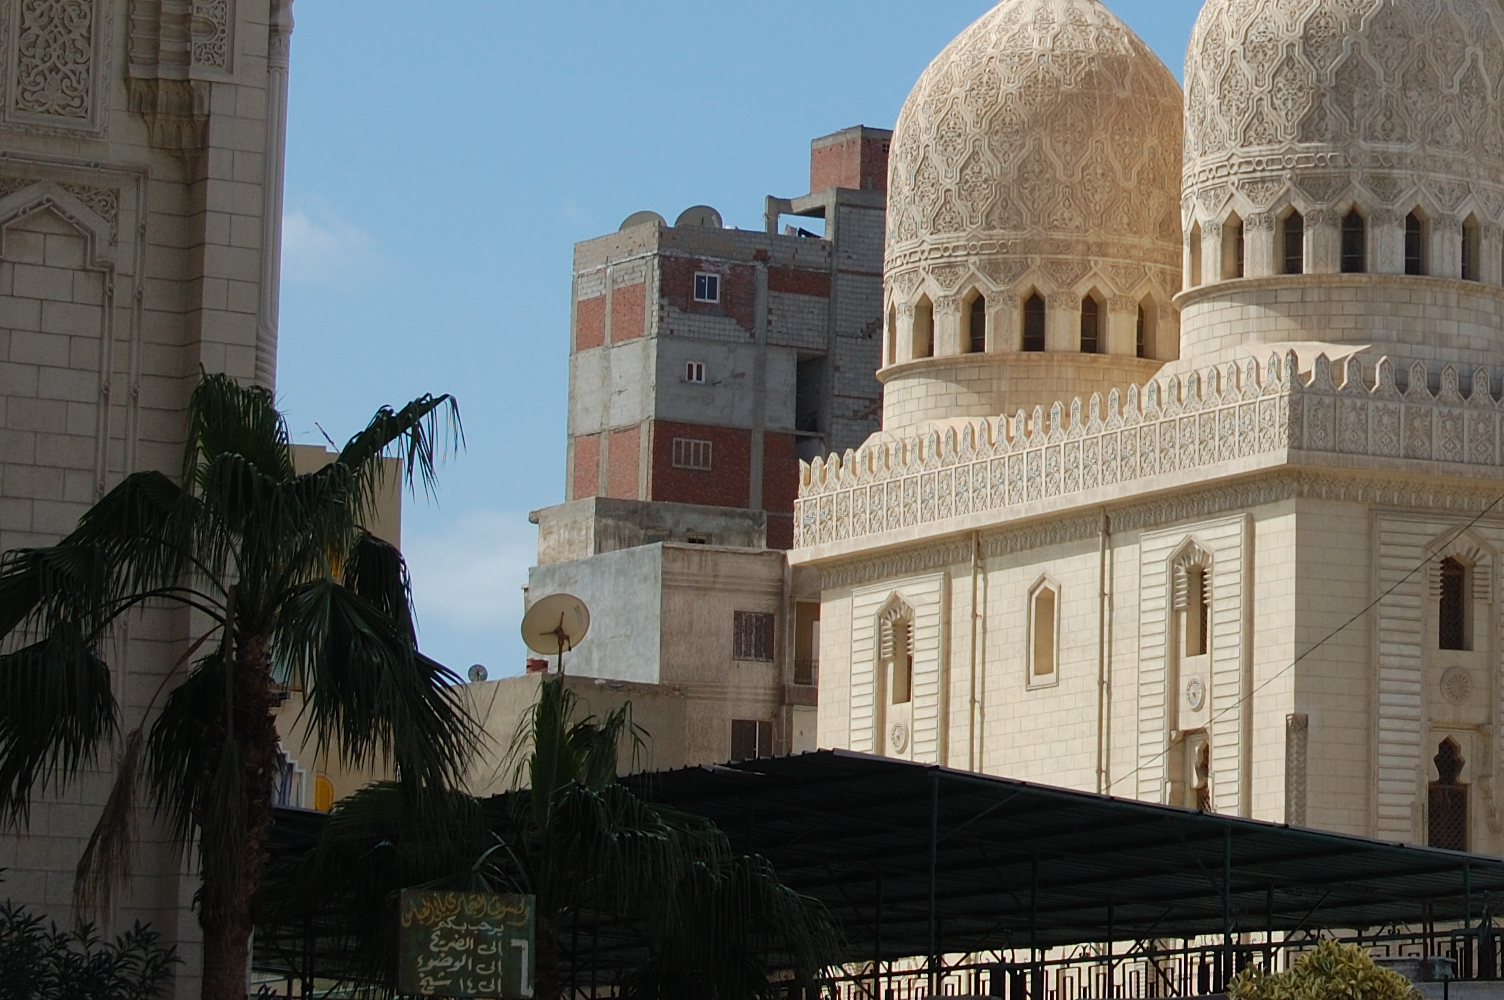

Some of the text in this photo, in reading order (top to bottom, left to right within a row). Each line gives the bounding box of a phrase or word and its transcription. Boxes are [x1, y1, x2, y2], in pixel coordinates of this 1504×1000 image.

[431, 915, 505, 937] يرحب بكم
[429, 930, 475, 952] الضريح
[416, 952, 473, 972] الوضوء
[419, 971, 453, 995] شيخ
